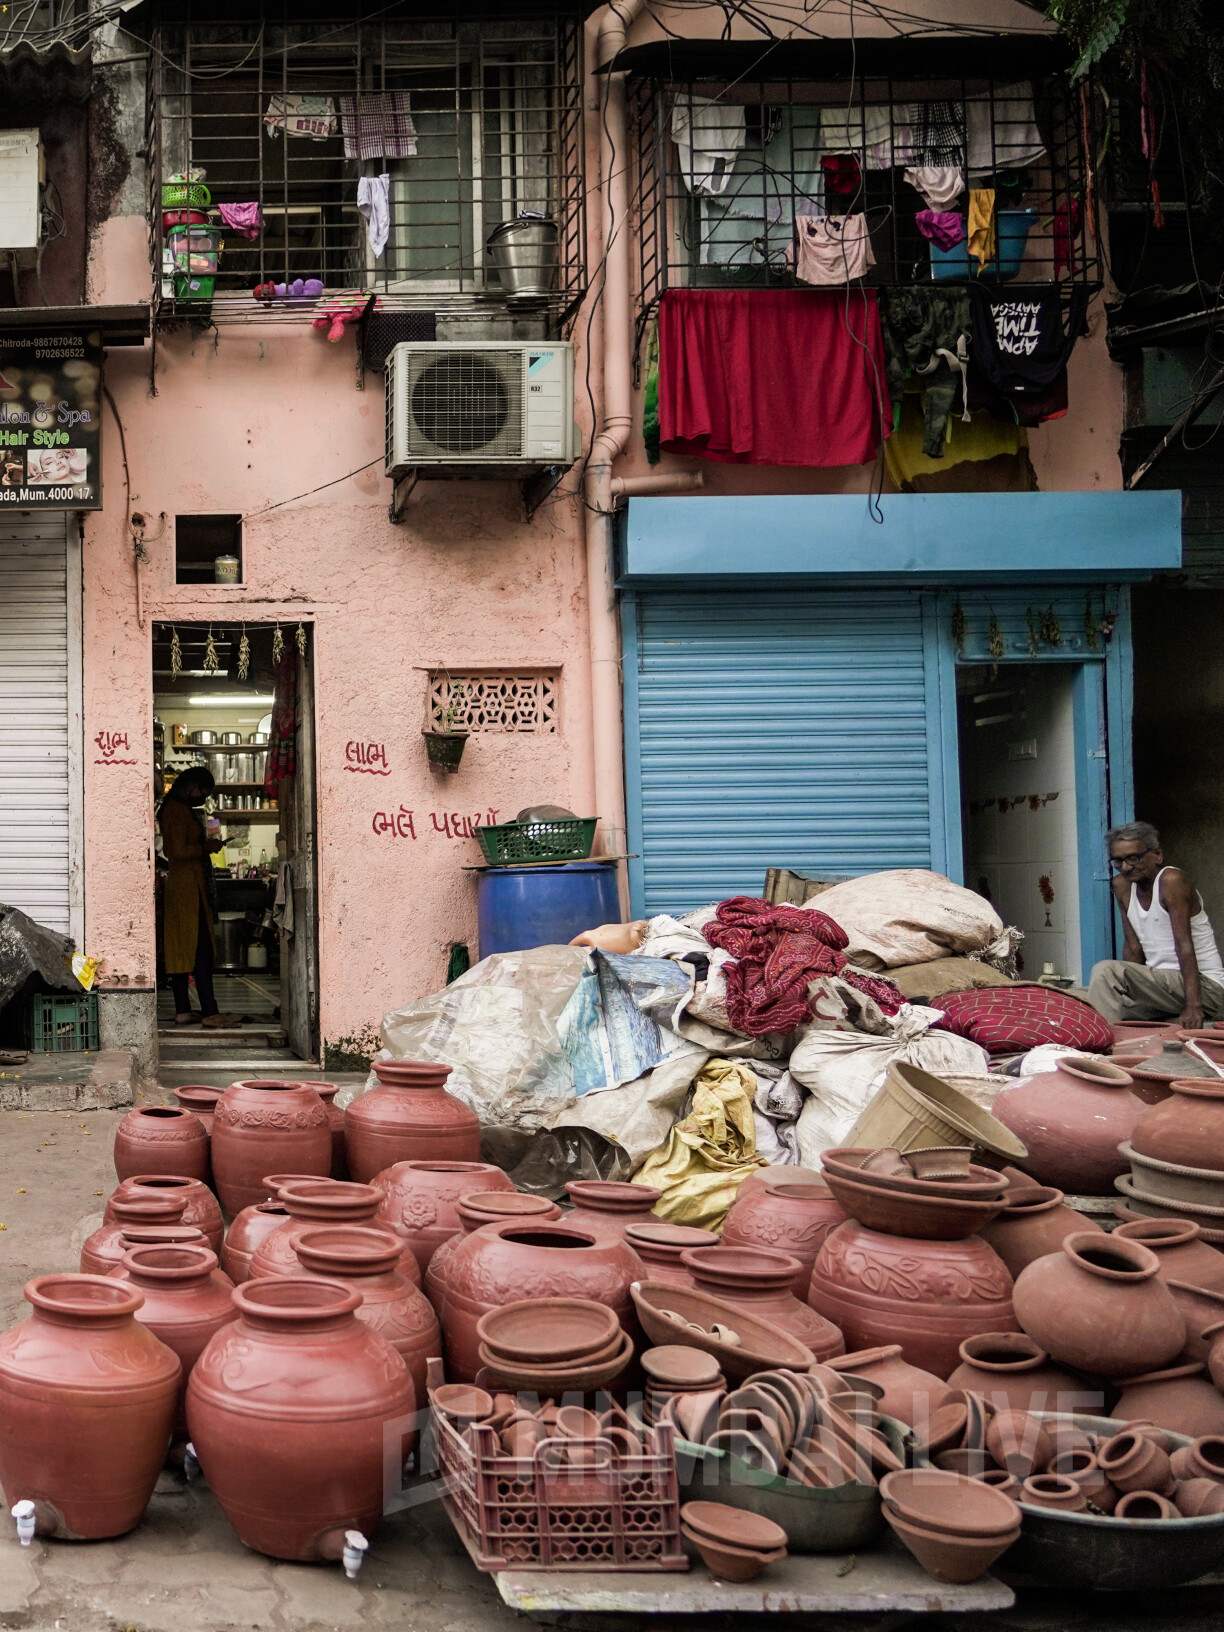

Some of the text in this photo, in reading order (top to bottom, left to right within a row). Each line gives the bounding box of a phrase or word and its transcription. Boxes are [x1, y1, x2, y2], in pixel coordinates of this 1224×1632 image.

[35, 348, 85, 358] 9702636522
[34, 401, 55, 423] &
[57, 400, 91, 428] Spa
[32, 428, 70, 448] Style
[78, 487, 94, 500] 17.
[345, 740, 389, 768] લાભ
[372, 804, 417, 840] ભલે
